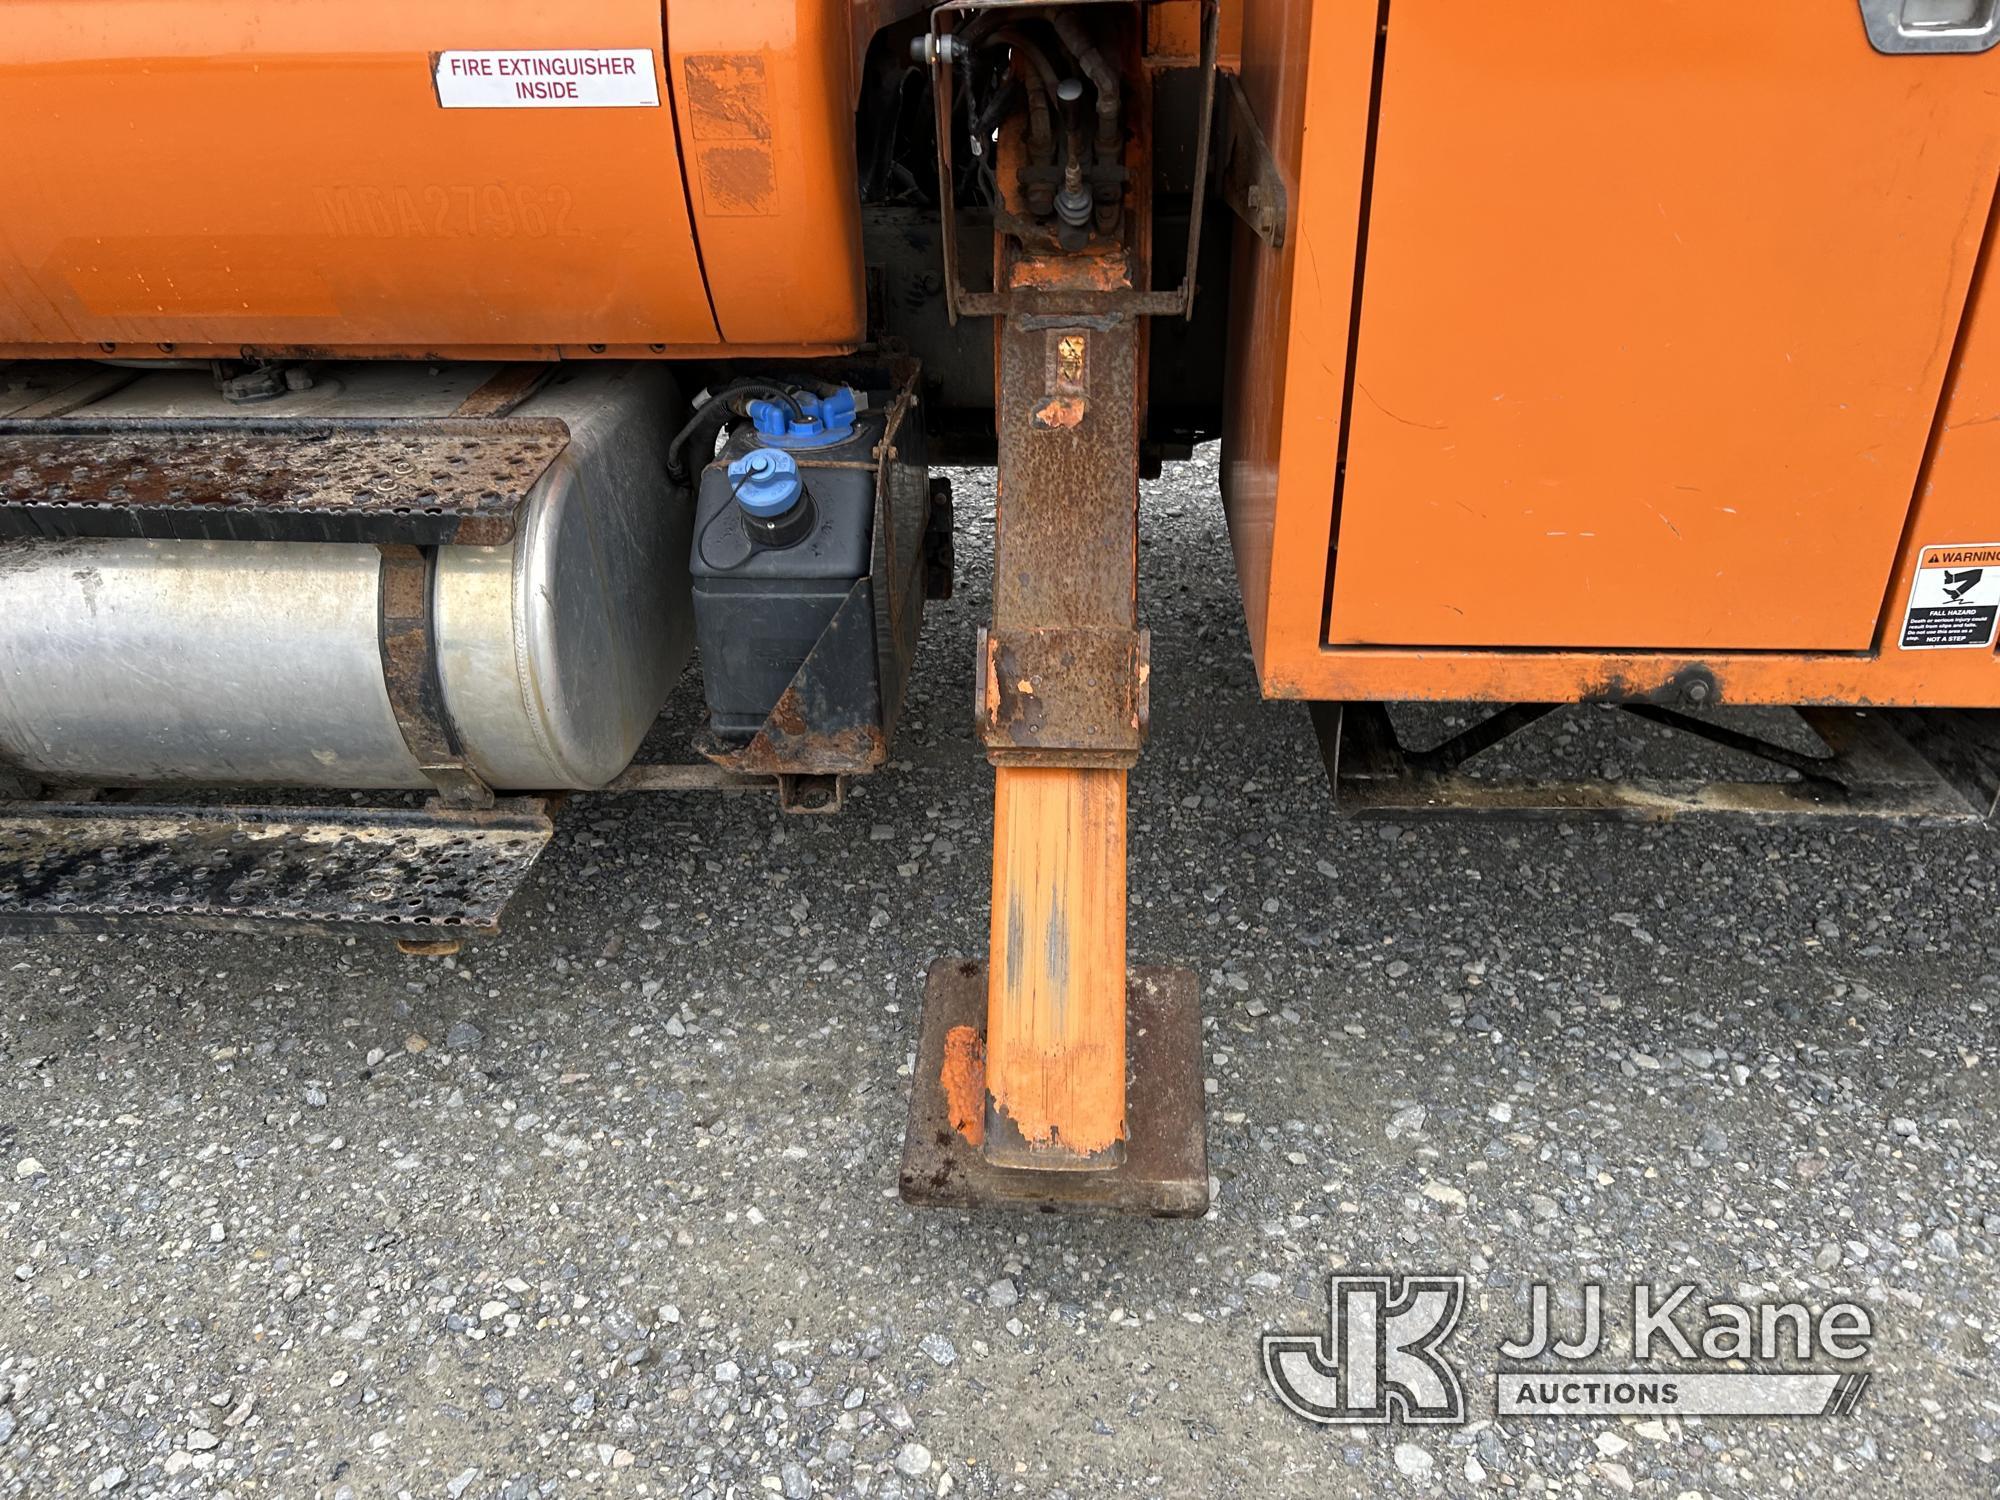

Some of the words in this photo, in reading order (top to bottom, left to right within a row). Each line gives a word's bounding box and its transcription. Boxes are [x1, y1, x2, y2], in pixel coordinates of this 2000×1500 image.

[450, 58, 493, 76] FIRE
[498, 57, 636, 76] EXTINGUISHER
[515, 81, 579, 99] INSIDE
